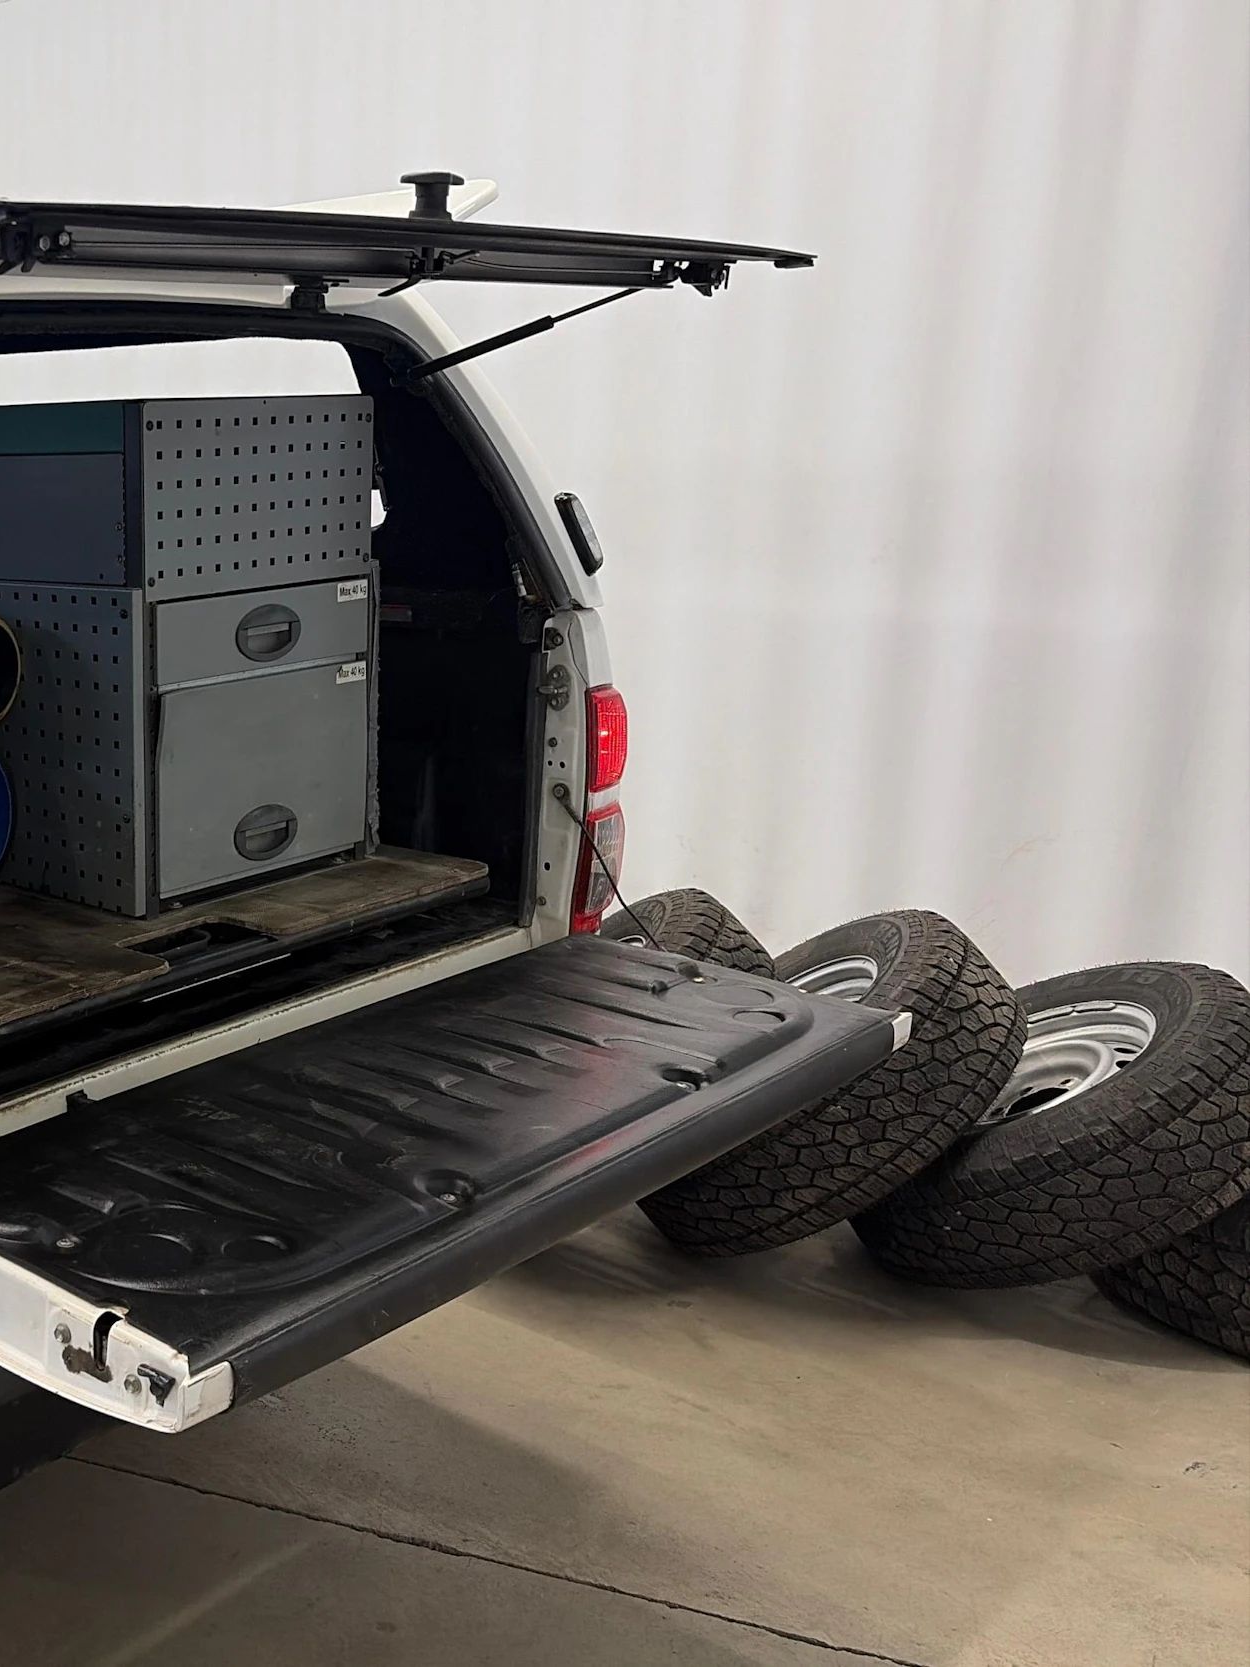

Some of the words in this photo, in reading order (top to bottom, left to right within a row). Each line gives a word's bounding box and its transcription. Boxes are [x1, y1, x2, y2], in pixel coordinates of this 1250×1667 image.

[340, 586, 351, 597] Max
[352, 584, 359, 595] 40
[360, 583, 367, 595] kg
[351, 666, 357, 676] 40
[358, 665, 365, 676] kg
